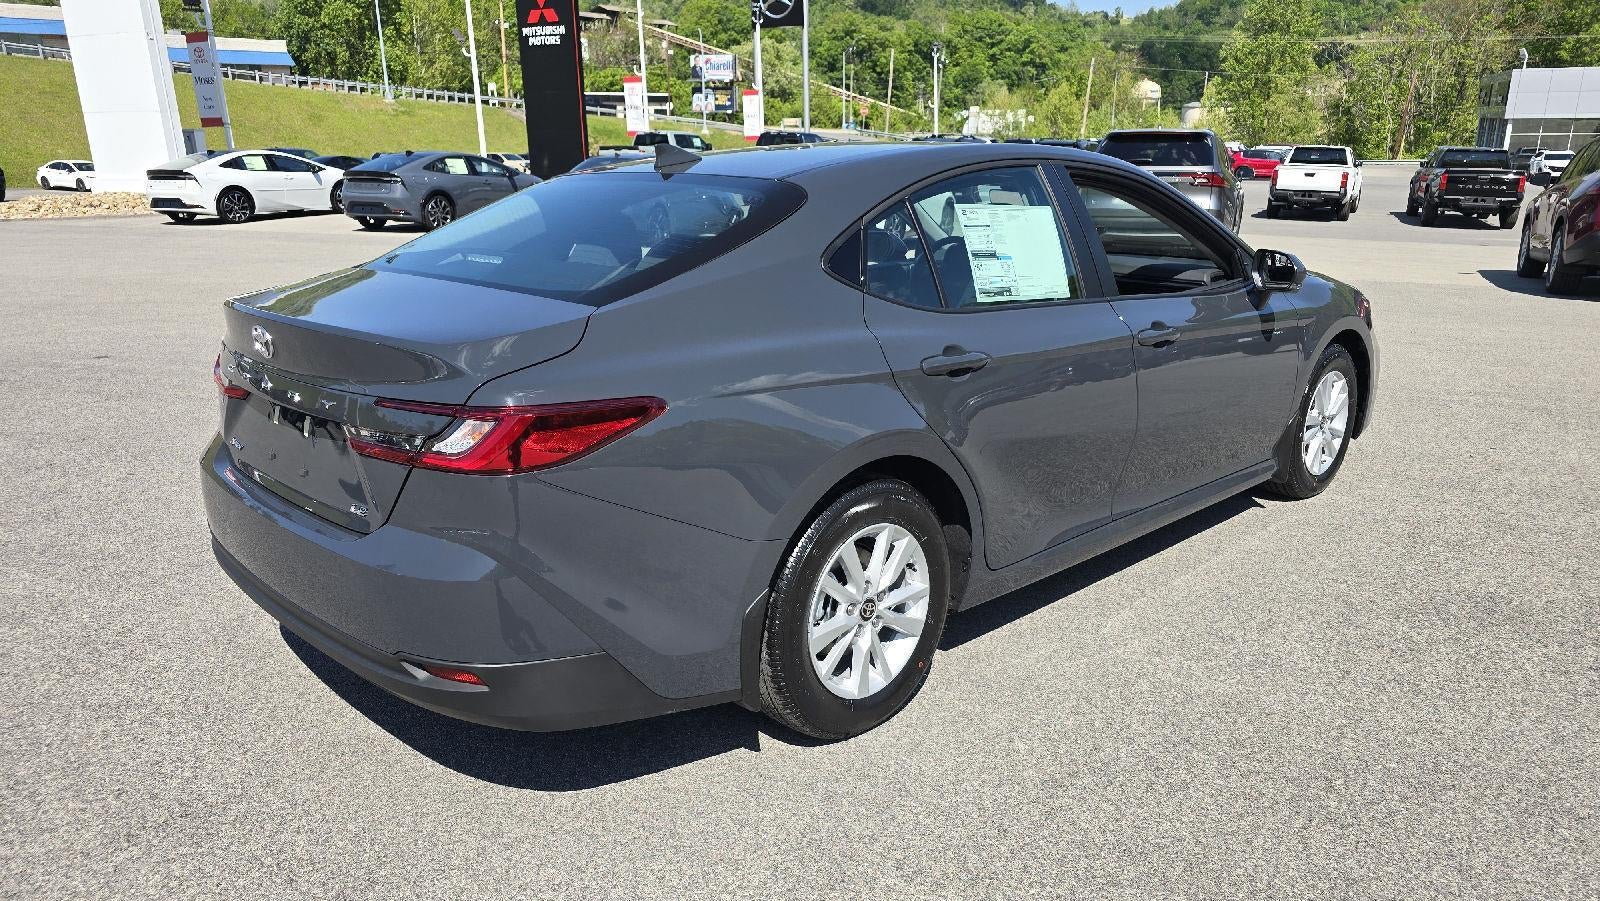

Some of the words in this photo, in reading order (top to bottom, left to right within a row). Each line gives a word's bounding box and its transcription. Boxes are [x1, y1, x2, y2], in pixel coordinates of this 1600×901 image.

[521, 25, 566, 37] MITSUBISHI
[528, 35, 561, 46] MOTORS
[194, 76, 215, 85] MOSES
